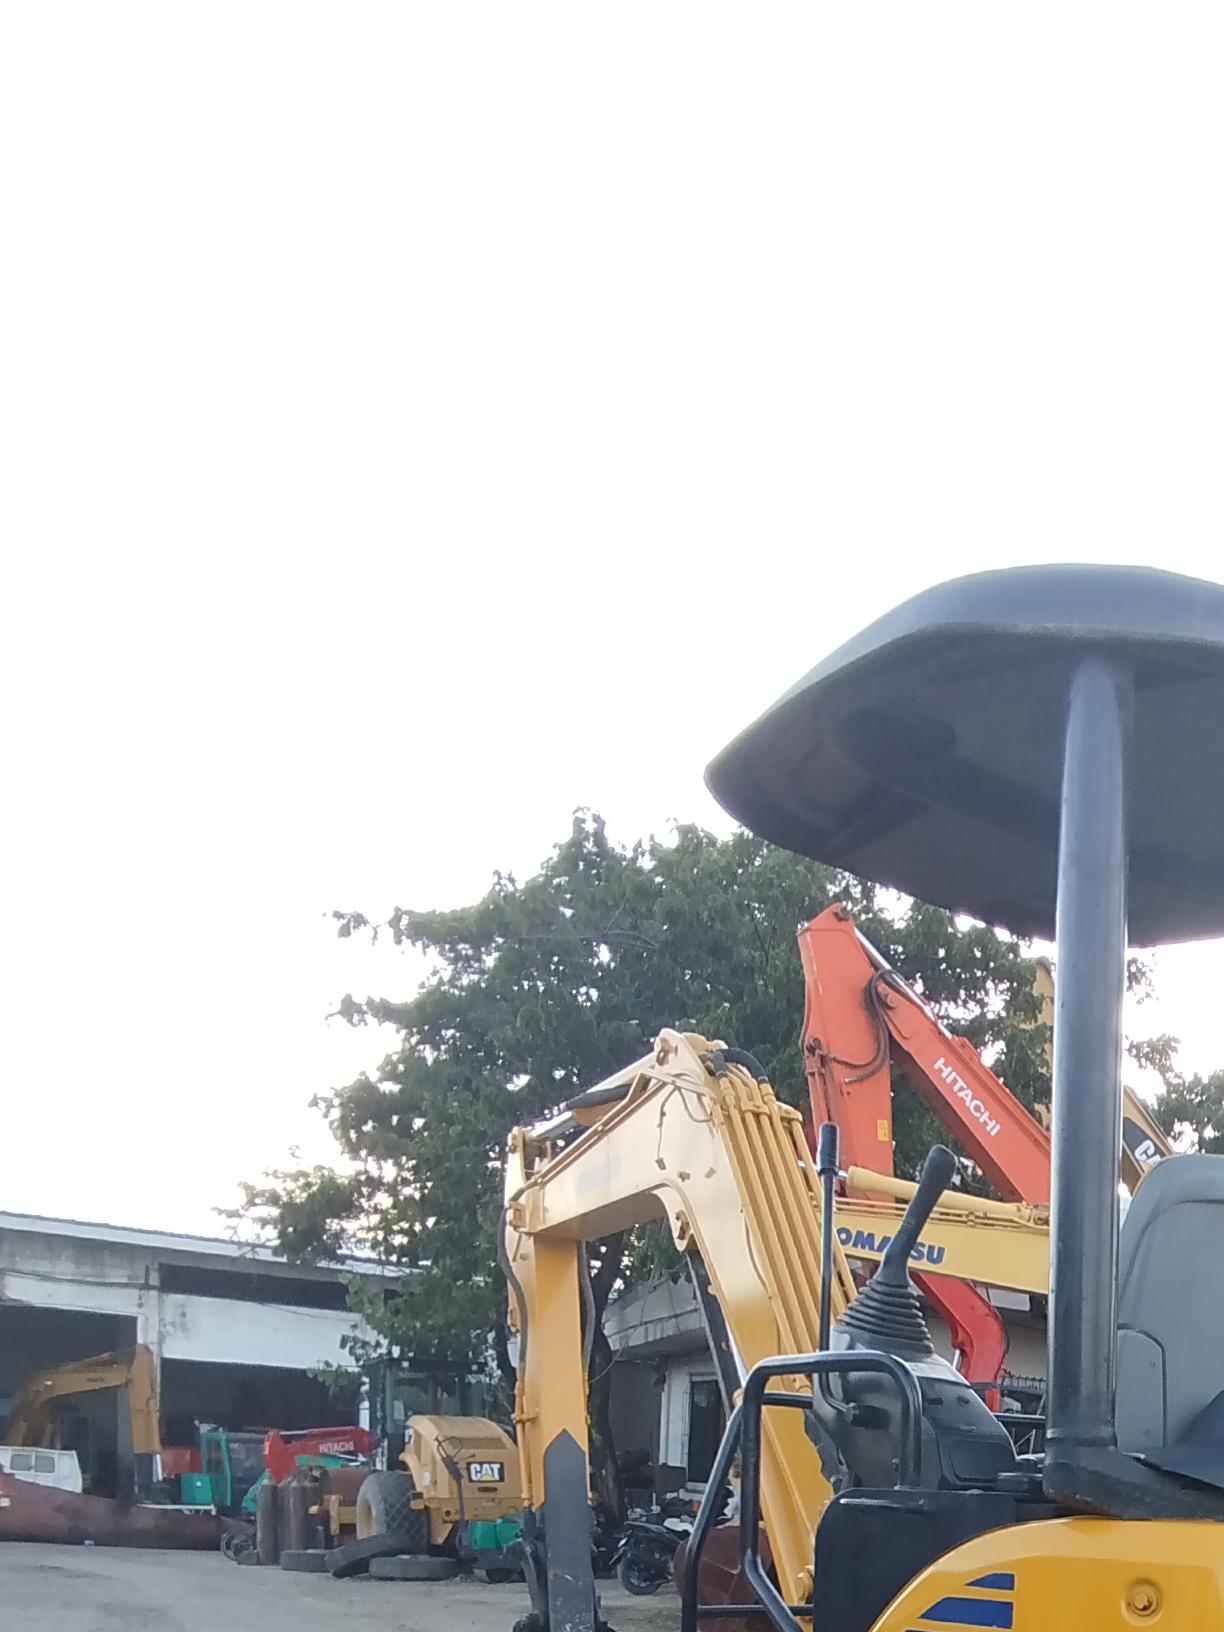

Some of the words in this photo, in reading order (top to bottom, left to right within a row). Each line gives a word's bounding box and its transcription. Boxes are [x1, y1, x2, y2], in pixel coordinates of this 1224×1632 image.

[933, 1057, 1001, 1137] HITACHI
[836, 1226, 945, 1264] OMASU
[319, 1440, 355, 1453] HITACHI
[470, 1463, 500, 1481] CAT
